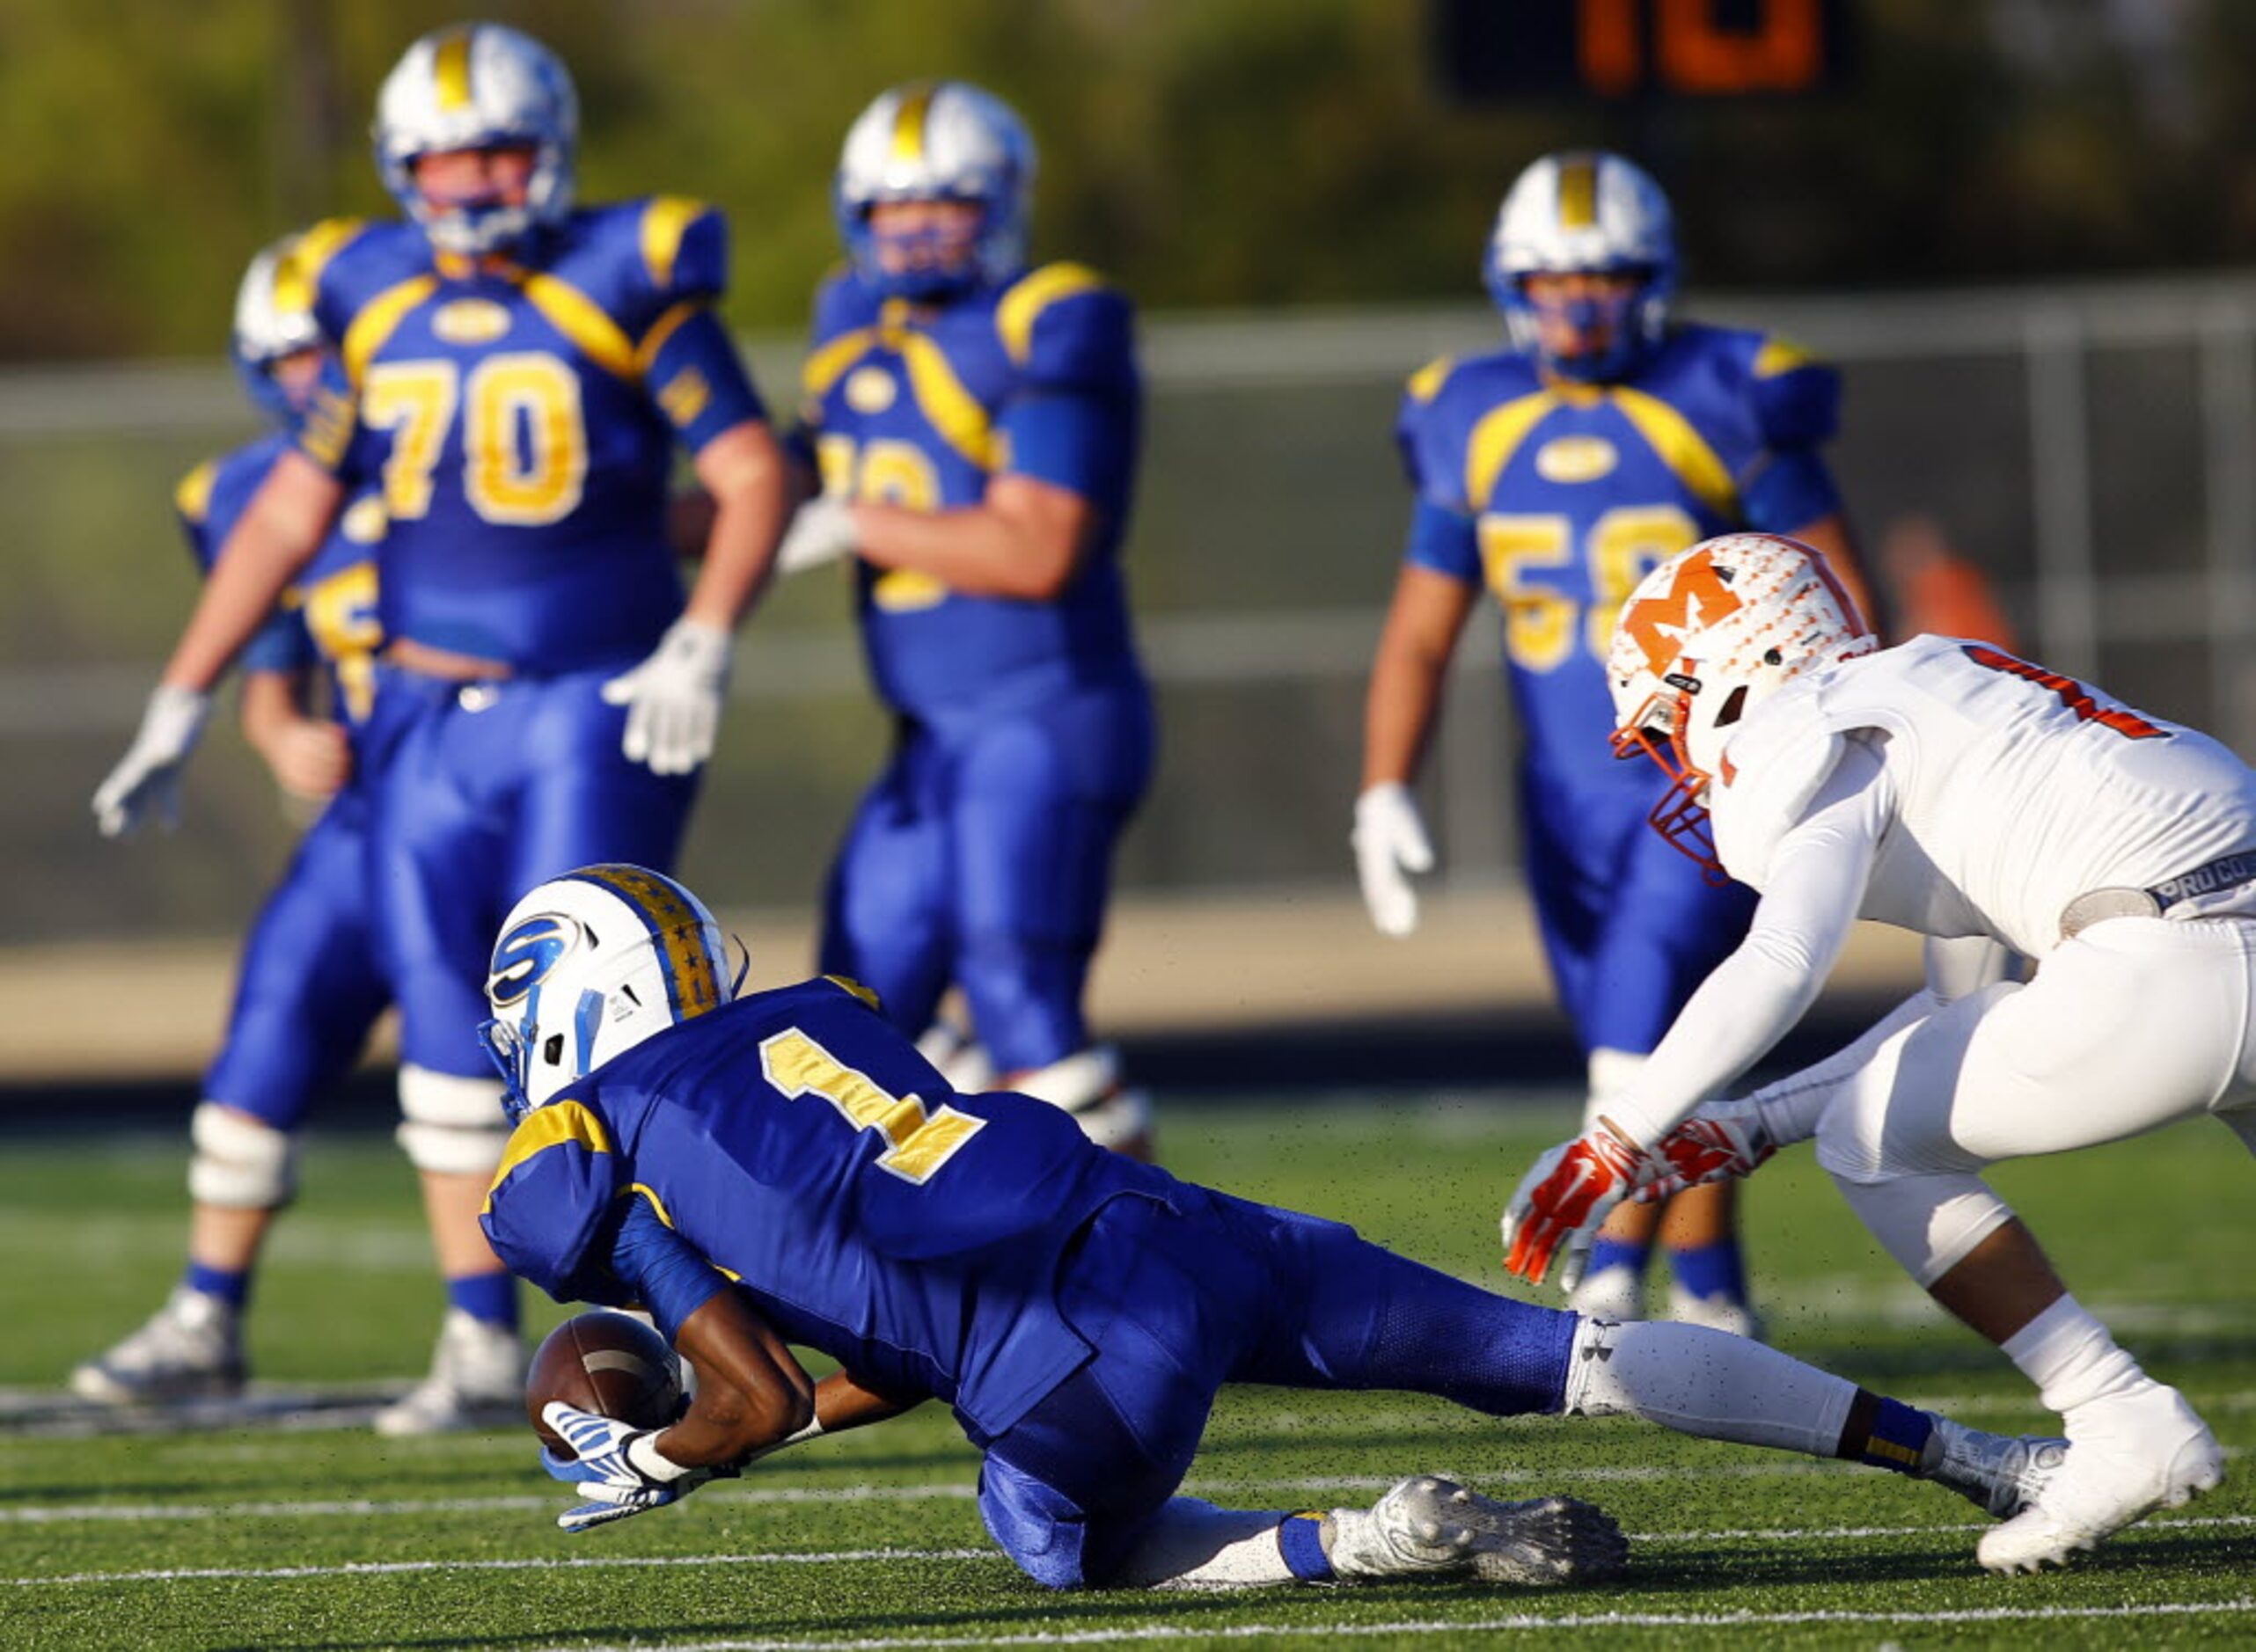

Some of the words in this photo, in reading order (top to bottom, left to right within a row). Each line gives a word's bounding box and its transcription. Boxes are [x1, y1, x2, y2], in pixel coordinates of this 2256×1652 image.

[361, 351, 589, 526] 70
[1623, 548, 1744, 680] M
[491, 917, 568, 1004] S
[758, 1026, 988, 1186] 1
